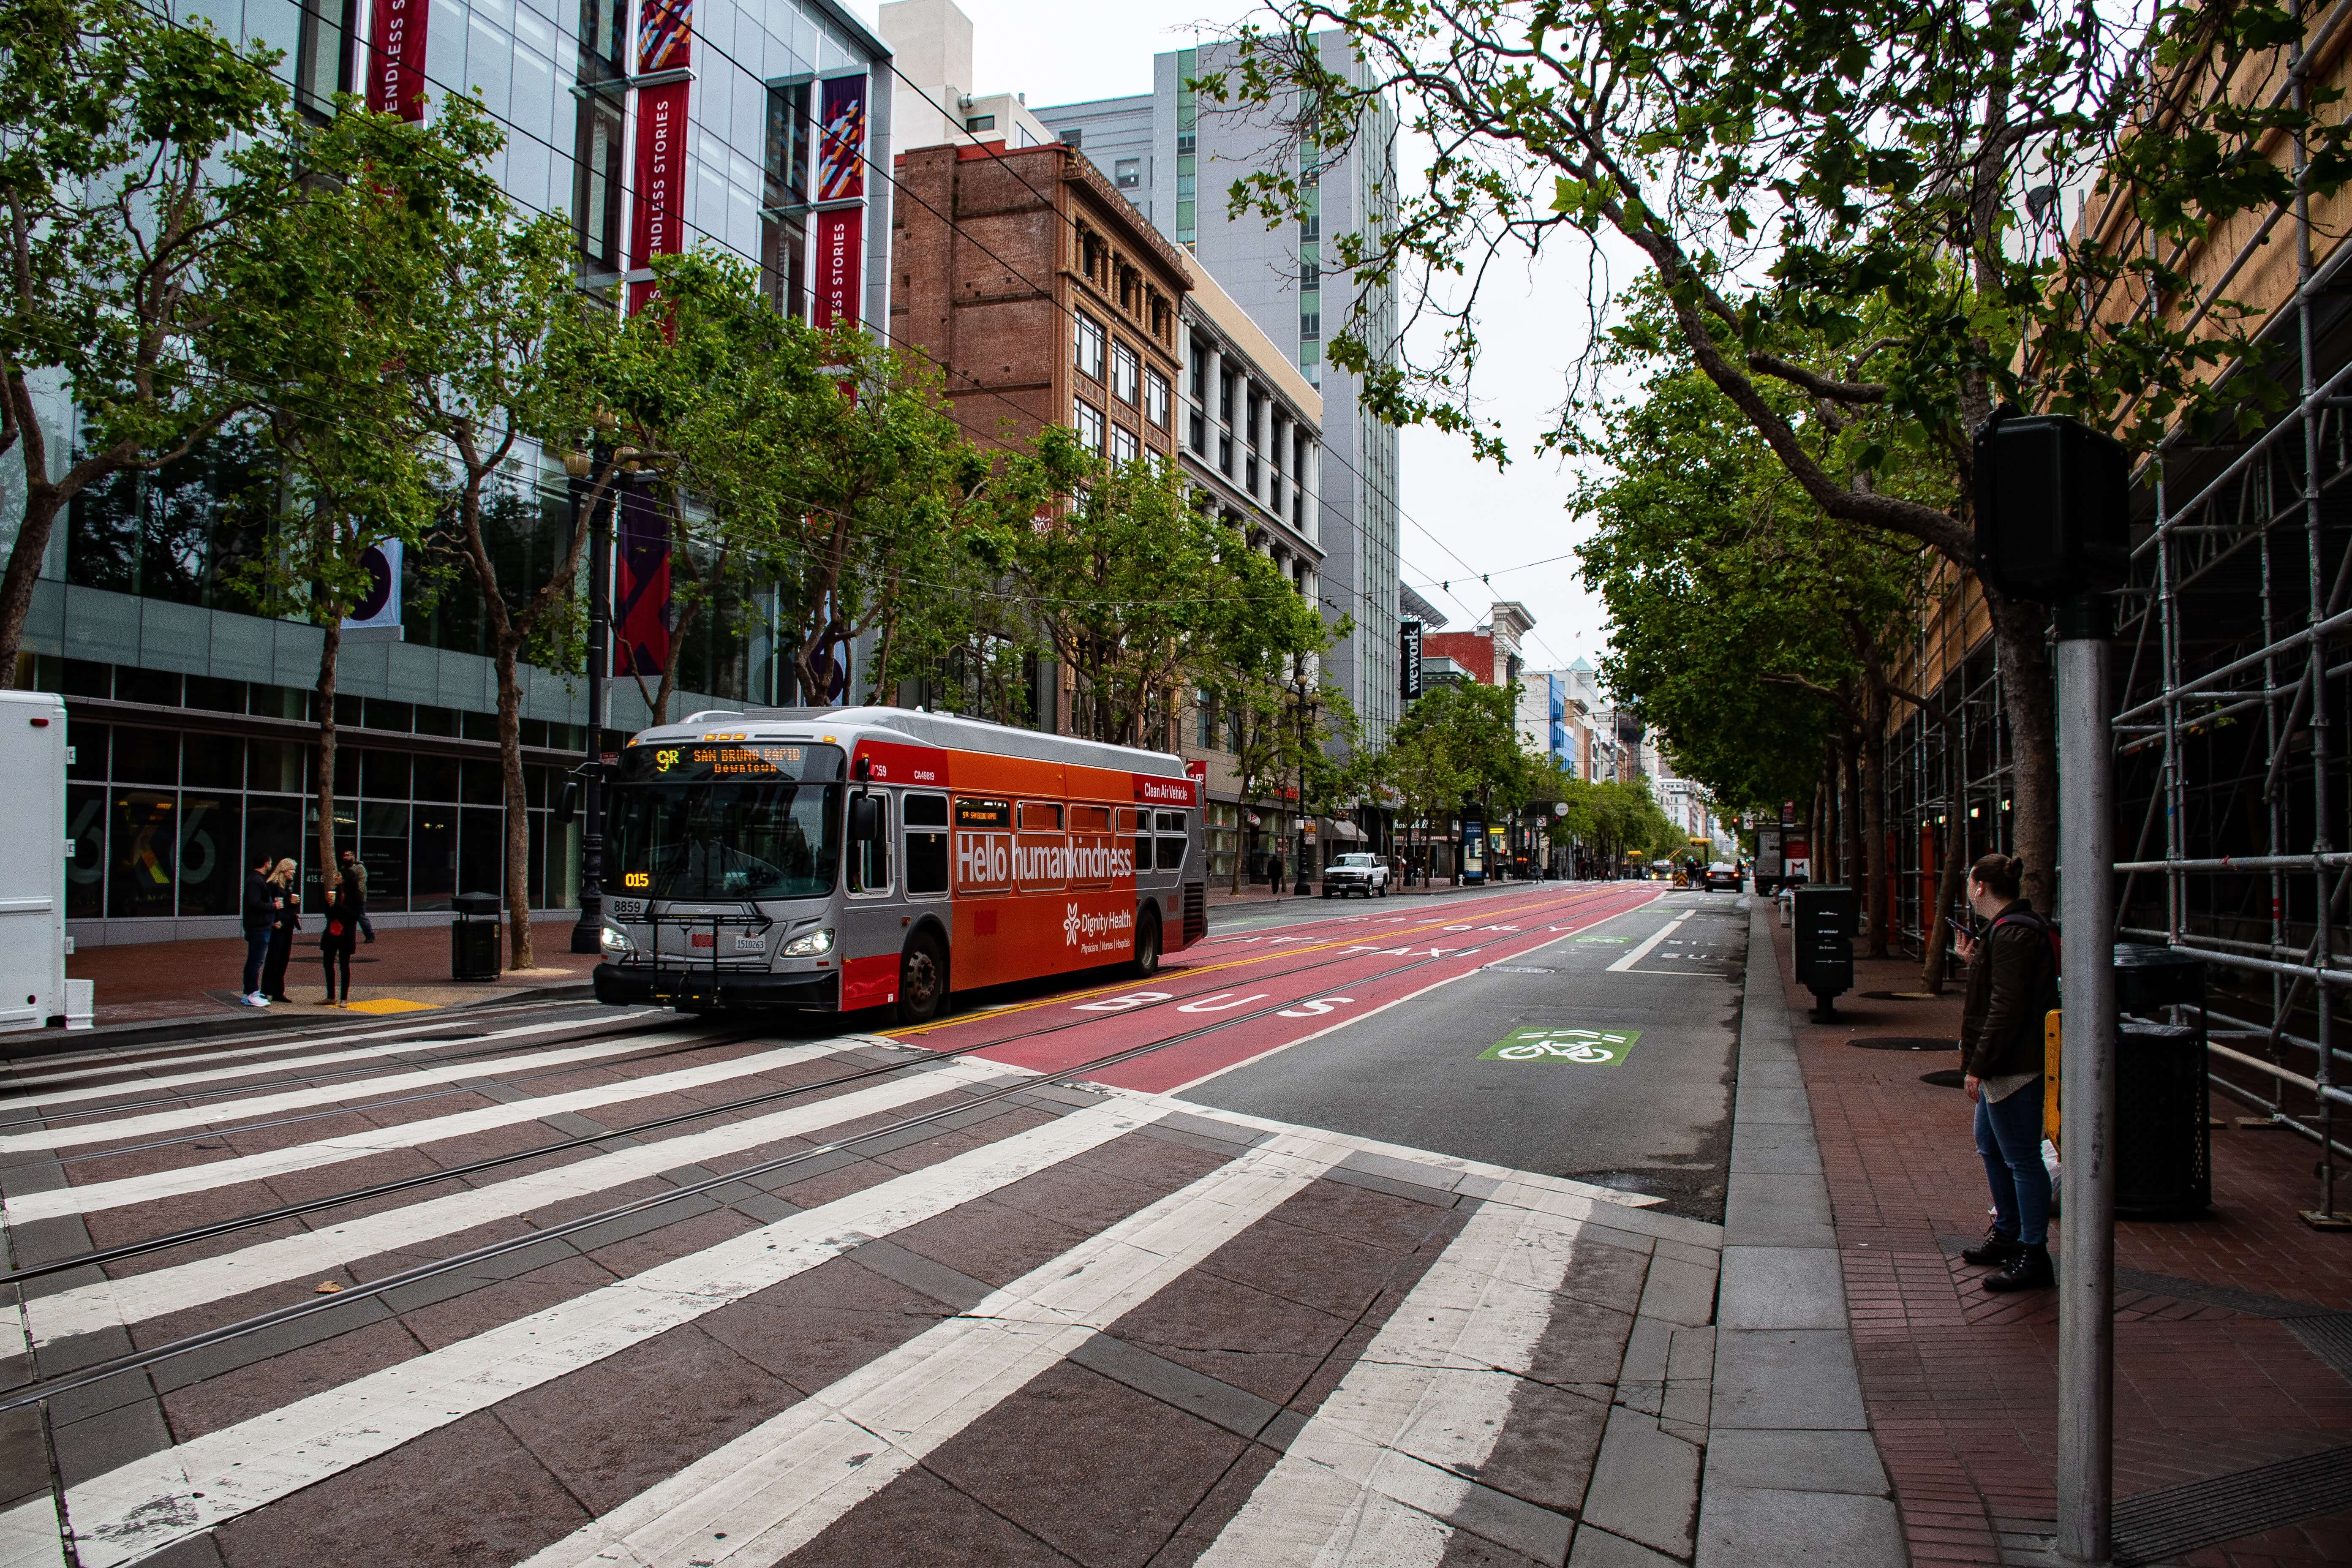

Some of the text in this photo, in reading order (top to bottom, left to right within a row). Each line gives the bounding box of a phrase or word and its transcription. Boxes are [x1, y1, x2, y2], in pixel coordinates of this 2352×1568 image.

[385, 18, 403, 112] ENDLESS
[650, 101, 669, 259] ENDLESS STORIES
[832, 223, 845, 285] STORIES
[1404, 628, 1418, 693] wework
[694, 749, 717, 762] SAN
[721, 749, 760, 761] BRUNO
[764, 748, 800, 761] RAPID
[713, 763, 777, 773] Downtown
[914, 770, 934, 781] CA49819
[1144, 782, 1160, 798] Clean
[1169, 785, 1187, 800] Vehicle
[958, 834, 1132, 882] Hello humankindness
[625, 873, 649, 887] 015
[614, 901, 641, 912] 8859
[1082, 909, 1131, 937] Dignity Health
[1443, 924, 1575, 932] ONLY
[1081, 938, 1130, 955] Physicians Nurses Hospitals
[1336, 945, 1482, 958] TAXI
[1071, 991, 1355, 1017] BUS
